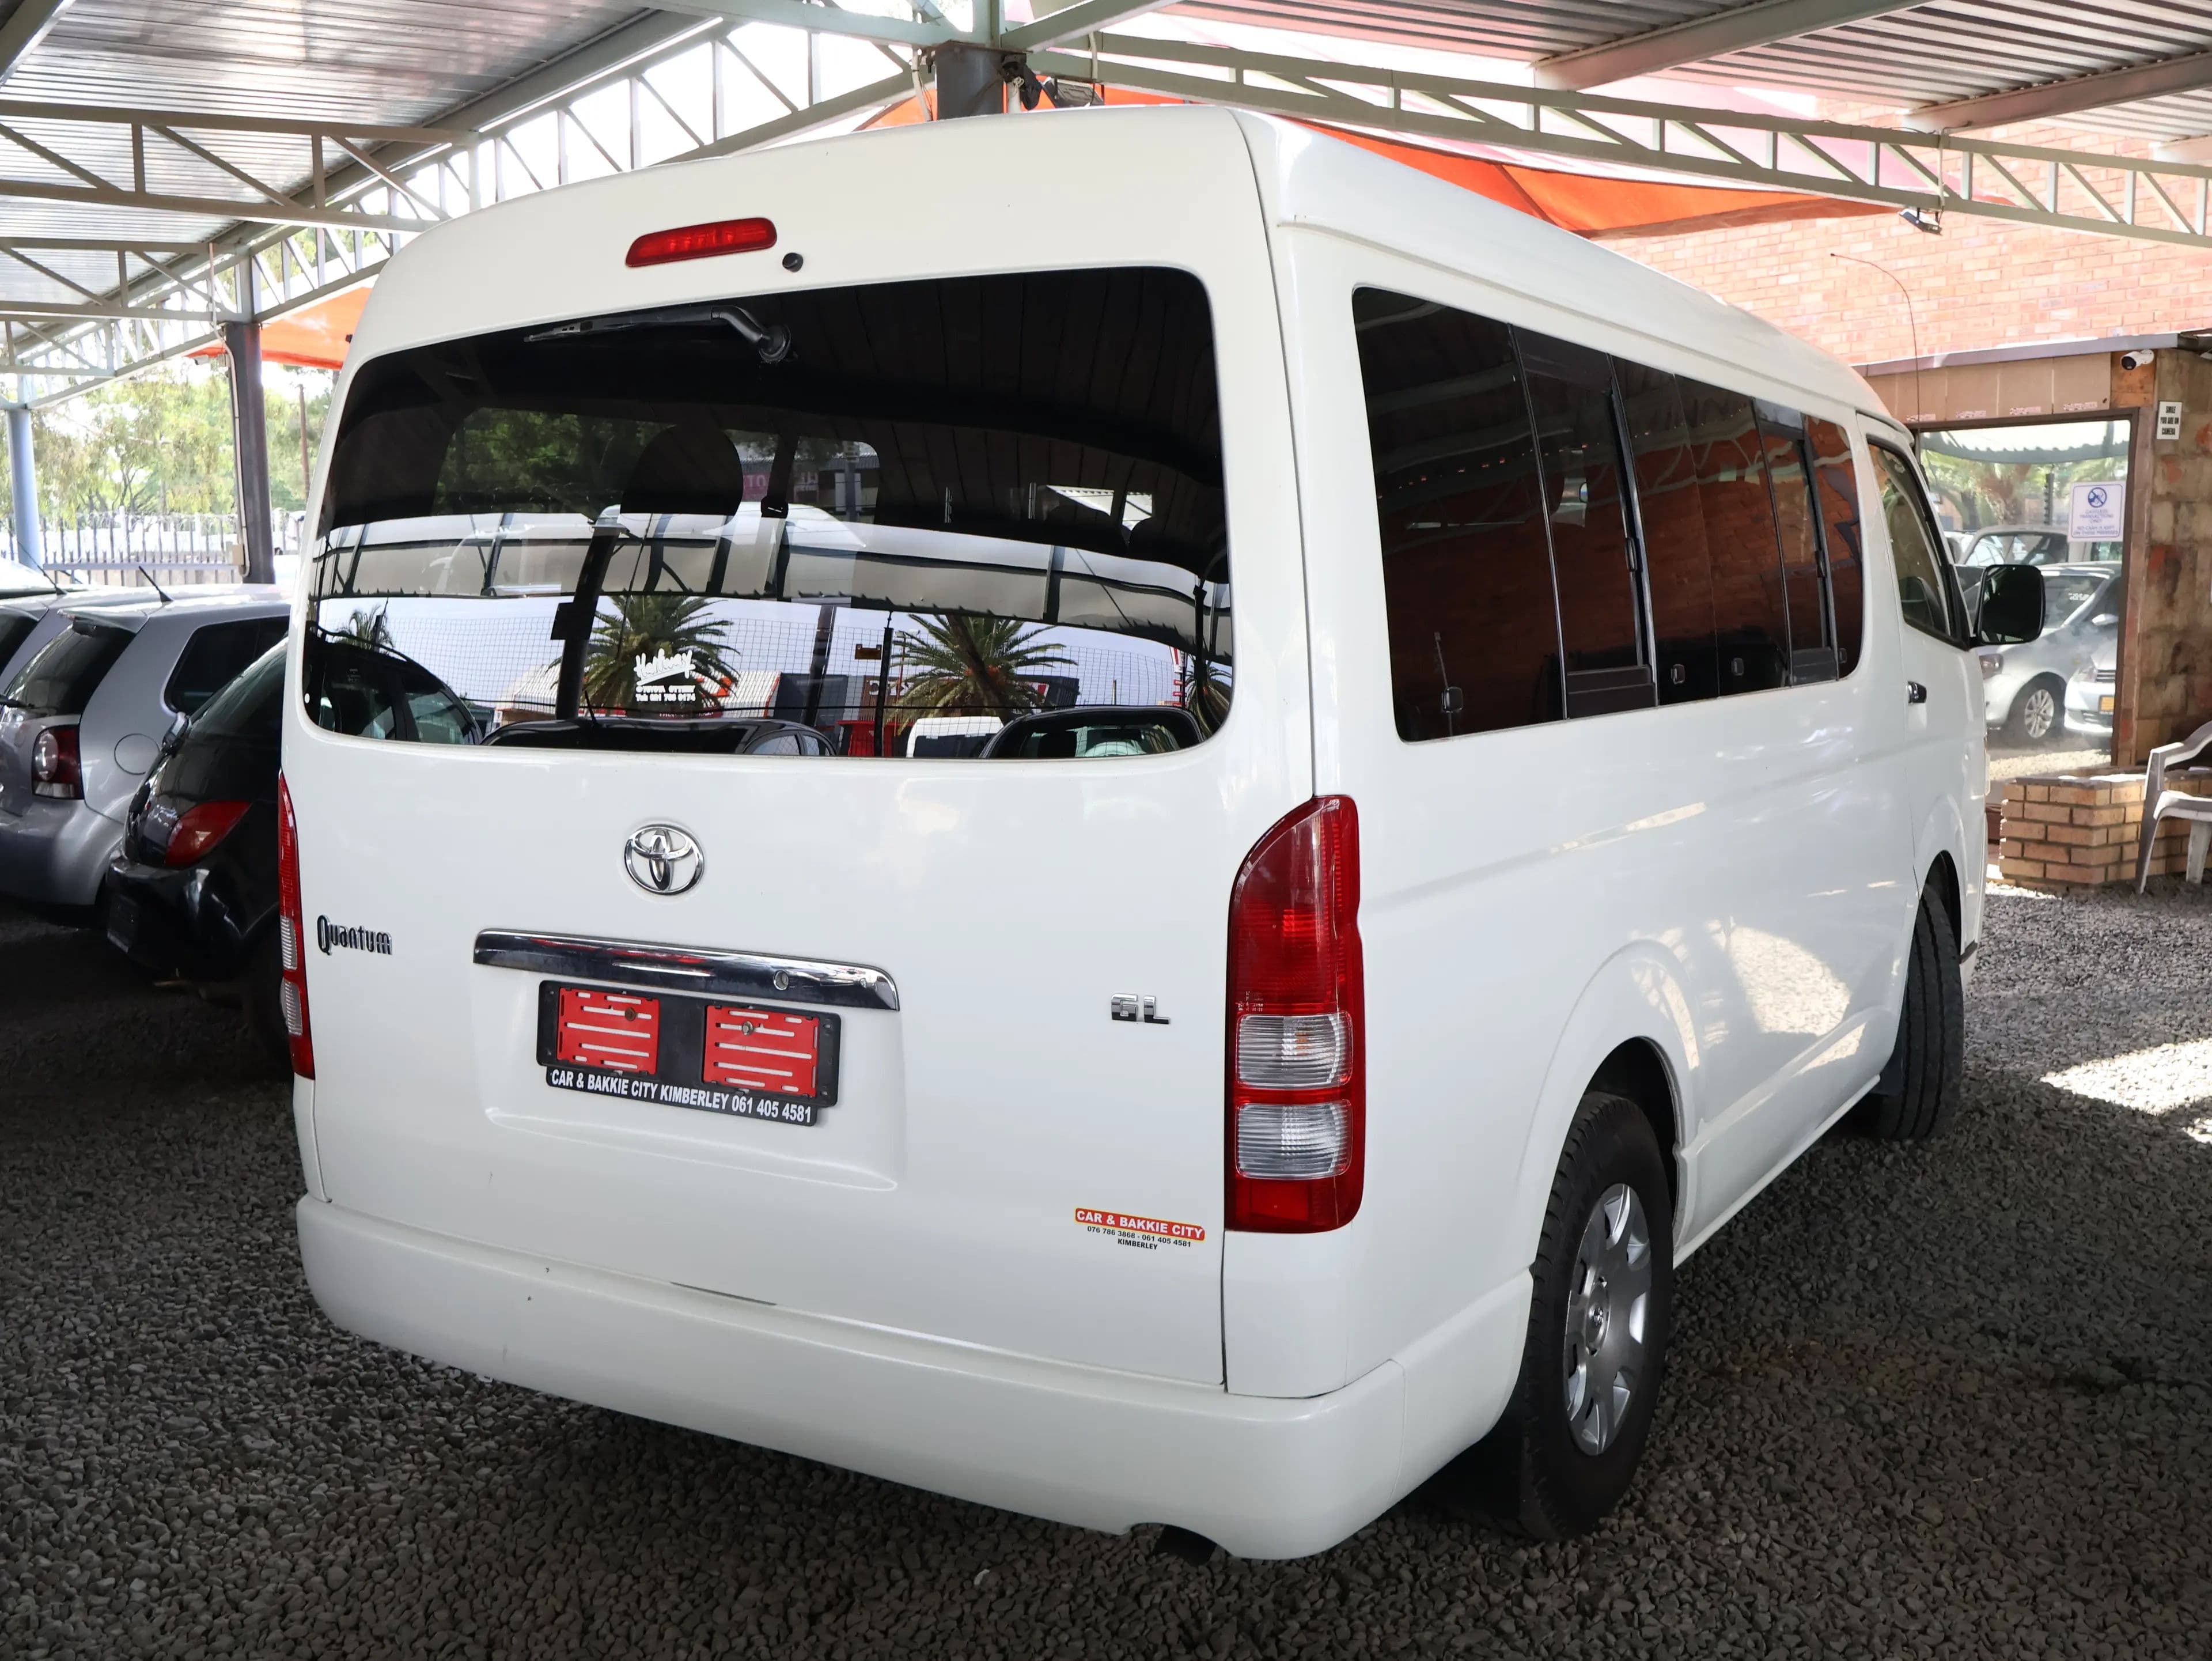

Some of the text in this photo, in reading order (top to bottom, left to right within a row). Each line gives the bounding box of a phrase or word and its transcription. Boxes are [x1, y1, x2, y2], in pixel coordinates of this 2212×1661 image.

[317, 914, 392, 956] Quantum
[1111, 993, 1171, 1024] GL
[552, 1069, 811, 1123] CAR & BAKKIE CITY KIMBERLEY 061 405 4581
[1077, 1210, 1203, 1239] CAR & BAKKIE CITY
[1118, 1231, 1135, 1239] 3868
[1157, 1236, 1171, 1244] 405
[1173, 1239, 1191, 1247] 4581
[1118, 1238, 1158, 1250] KIMBERLEY
